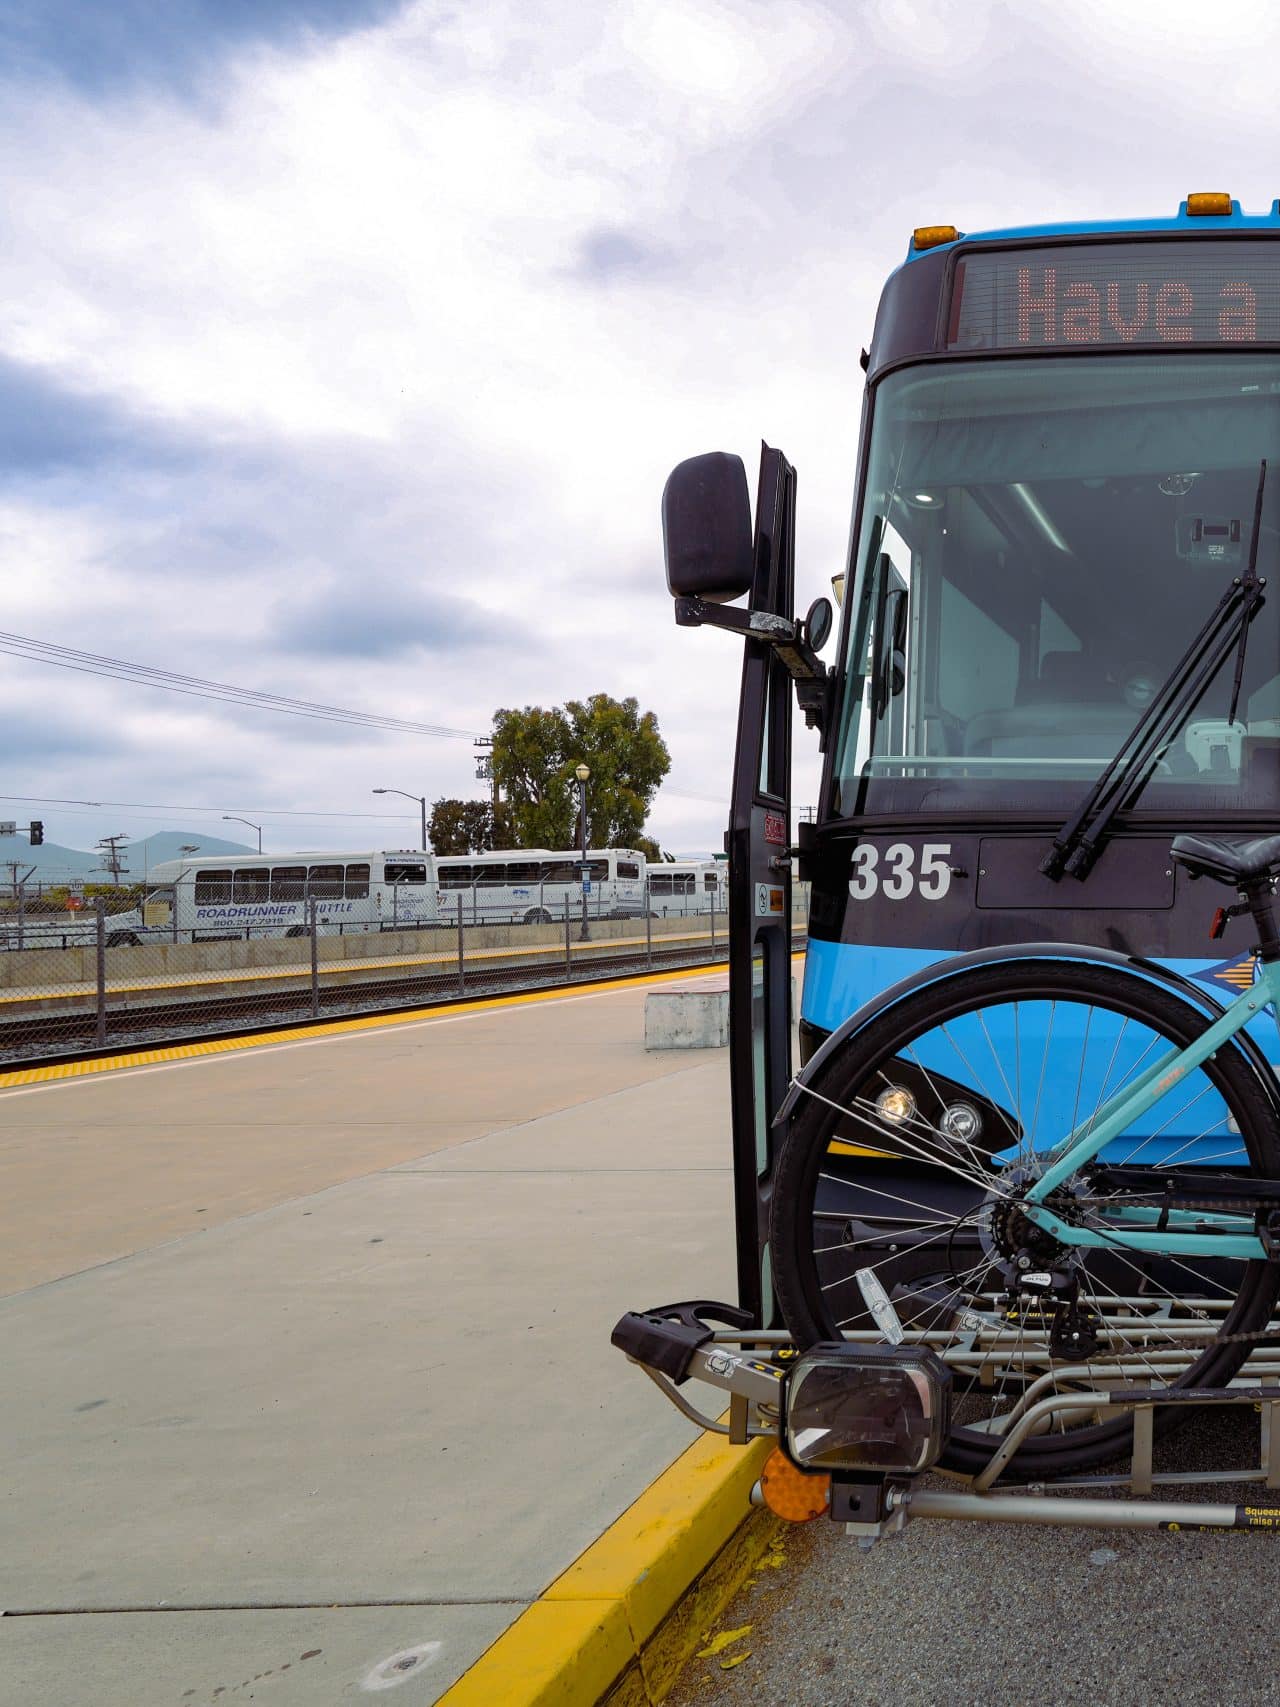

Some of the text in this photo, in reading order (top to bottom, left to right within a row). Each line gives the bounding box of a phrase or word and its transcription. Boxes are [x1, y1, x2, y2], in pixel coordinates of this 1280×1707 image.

[1018, 267, 1194, 342] Have
[1218, 281, 1257, 342] a
[848, 843, 951, 900] 335
[197, 905, 296, 919] ROADRUNNER
[1249, 1516, 1273, 1526] raise
